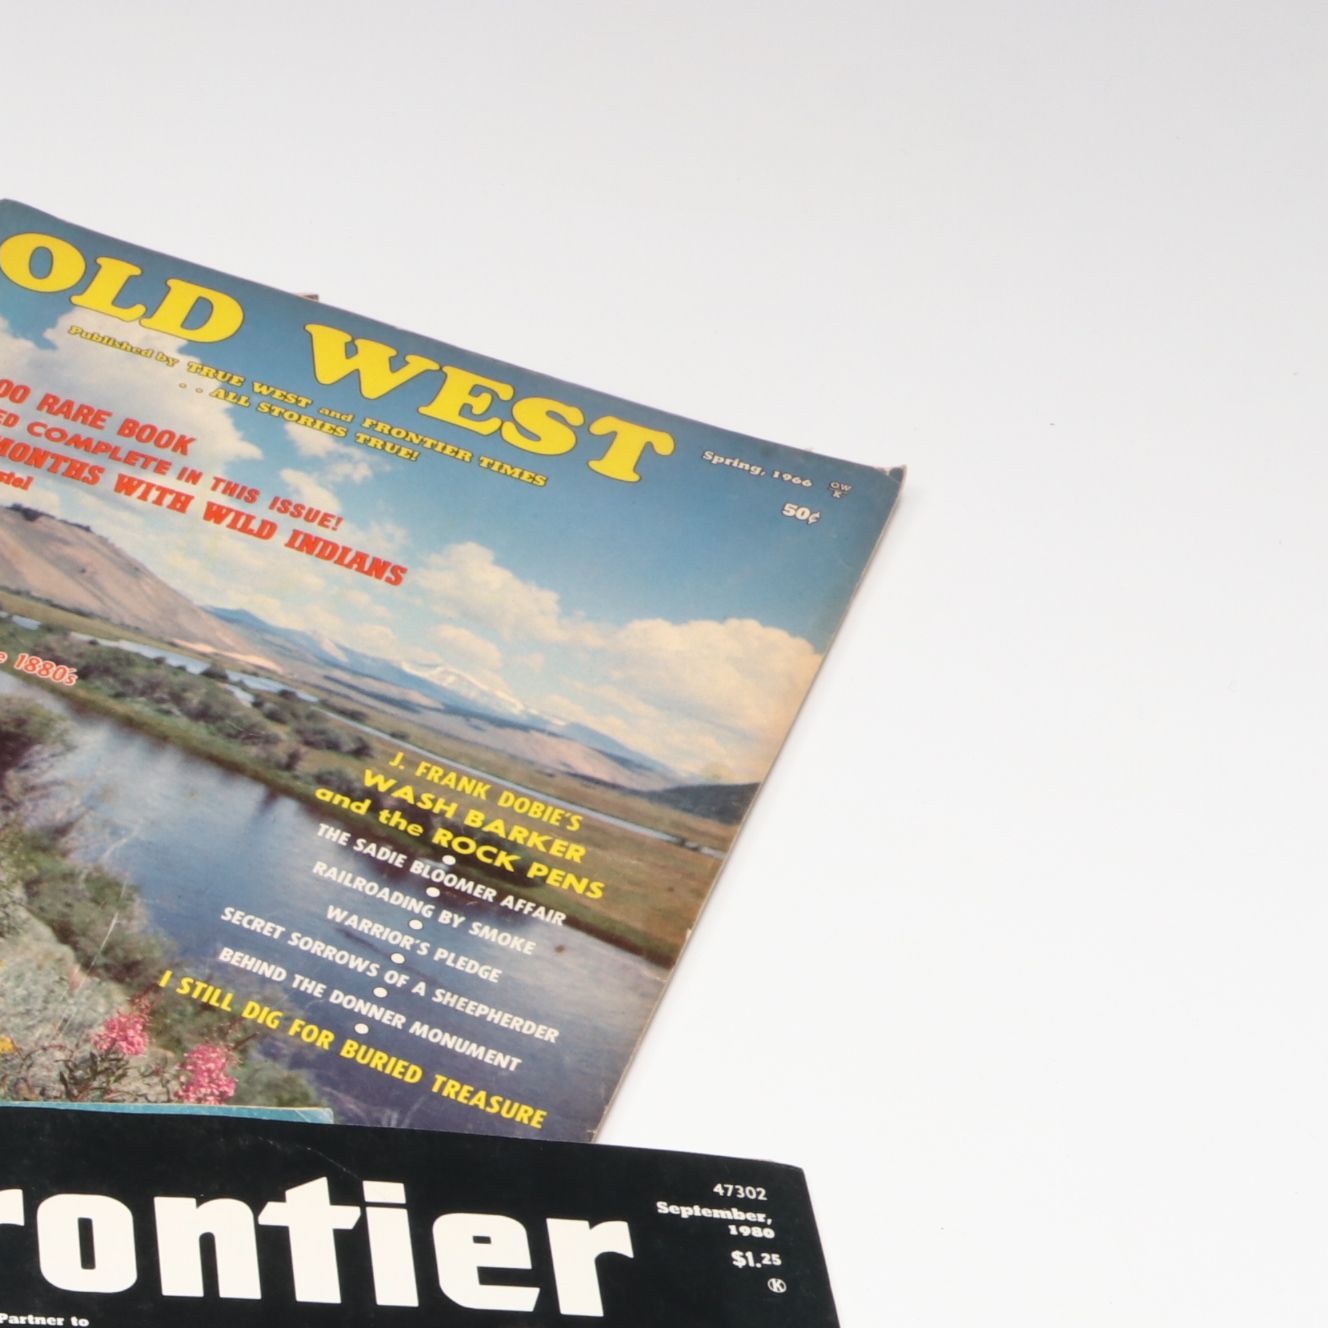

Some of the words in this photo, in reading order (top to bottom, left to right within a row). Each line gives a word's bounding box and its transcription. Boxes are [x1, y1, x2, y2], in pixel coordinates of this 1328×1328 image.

[37, 393, 113, 431] RARE
[117, 418, 197, 456] BOOK
[68, 325, 163, 361] Published
[155, 351, 180, 367] by
[187, 361, 245, 388] TRUE
[251, 381, 314, 411] WEST
[319, 406, 355, 423] and
[362, 417, 473, 464] FRONTIER
[479, 453, 548, 488] TIMES
[303, 323, 675, 482] WEST
[702, 449, 765, 477] Spring,
[772, 471, 812, 488] 1966
[113, 473, 195, 514] WITH
[201, 500, 278, 541] WILD
[284, 528, 409, 587] INDIANS
[13, 653, 78, 687] 1880's
[315, 787, 372, 816] and
[378, 808, 425, 838] the
[431, 829, 521, 871] ROCK
[526, 862, 606, 900] PENS
[362, 769, 459, 820] WASH
[463, 810, 587, 864] BARKER
[220, 907, 284, 943] SECRET
[287, 933, 380, 978] SORROWS
[384, 968, 410, 987] OF
[411, 981, 426, 996] A
[431, 988, 560, 1043] SHEEPHERDER
[159, 970, 172, 987] I
[176, 977, 233, 1012] STILL
[242, 1001, 281, 1029] DIG
[288, 1018, 337, 1049] FOR
[340, 1039, 424, 1084] BURIED
[430, 1074, 548, 1129] TREASURE
[657, 1202, 772, 1224] September,
[713, 1183, 767, 1200] 47302
[729, 1224, 775, 1239] 1980
[732, 1250, 782, 1269] $1.25
[71, 1315, 89, 1327] to
